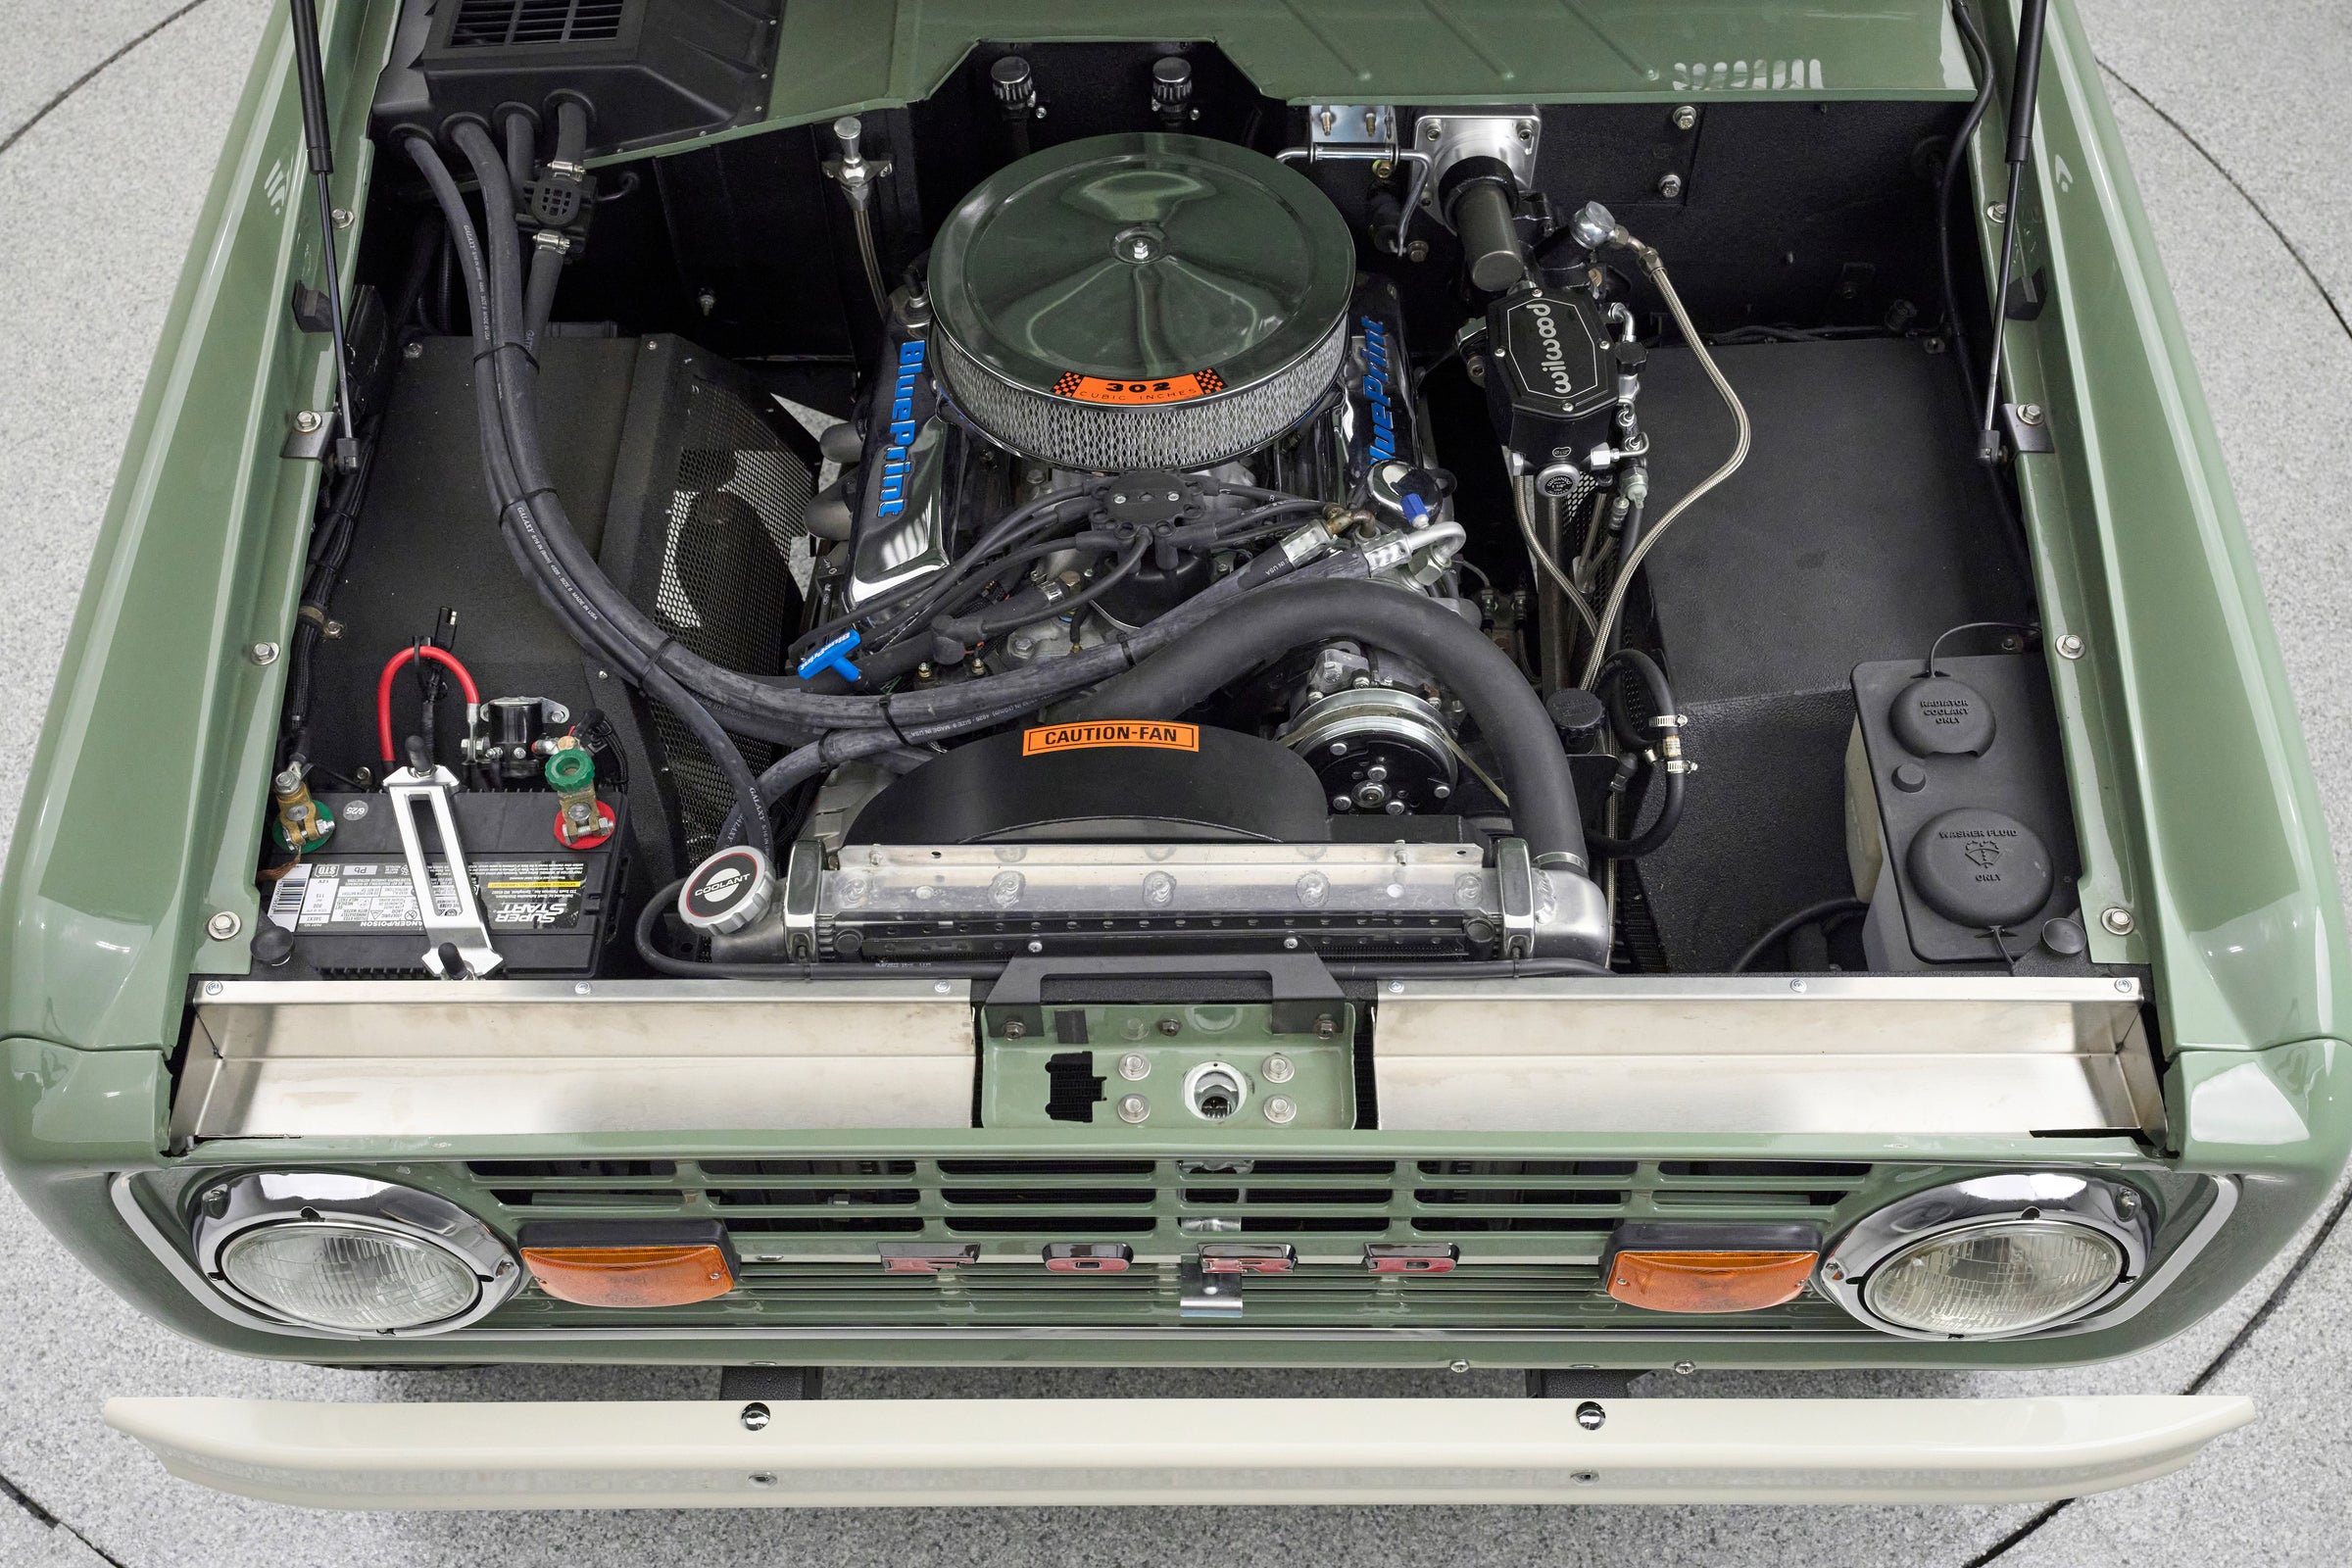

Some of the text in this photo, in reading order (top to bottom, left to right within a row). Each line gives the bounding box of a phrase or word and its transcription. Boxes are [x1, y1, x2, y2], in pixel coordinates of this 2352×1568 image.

[1526, 304, 1572, 394] wilwood
[1105, 382, 1171, 393] 302
[1361, 315, 1396, 466] luePrint
[1080, 388, 1198, 401] CUBIC INCHES
[877, 340, 926, 517] BluePrint
[516, 507, 535, 533] GALAXY
[571, 592, 584, 606] MADE
[587, 610, 598, 620] USA
[1264, 564, 1279, 575] USA
[1921, 699, 1969, 708] RADIATOR
[1924, 708, 1969, 716] COOLANT
[1045, 726, 1177, 745] CAUTION-FAN
[749, 787, 765, 821] GALAXY
[346, 807, 366, 815] 6/25
[1938, 830, 1984, 839] WASHER
[1975, 873, 2001, 882] ONLY
[695, 873, 751, 896] COOLANT
[496, 902, 567, 914] START
[494, 913, 556, 923] SUPER
